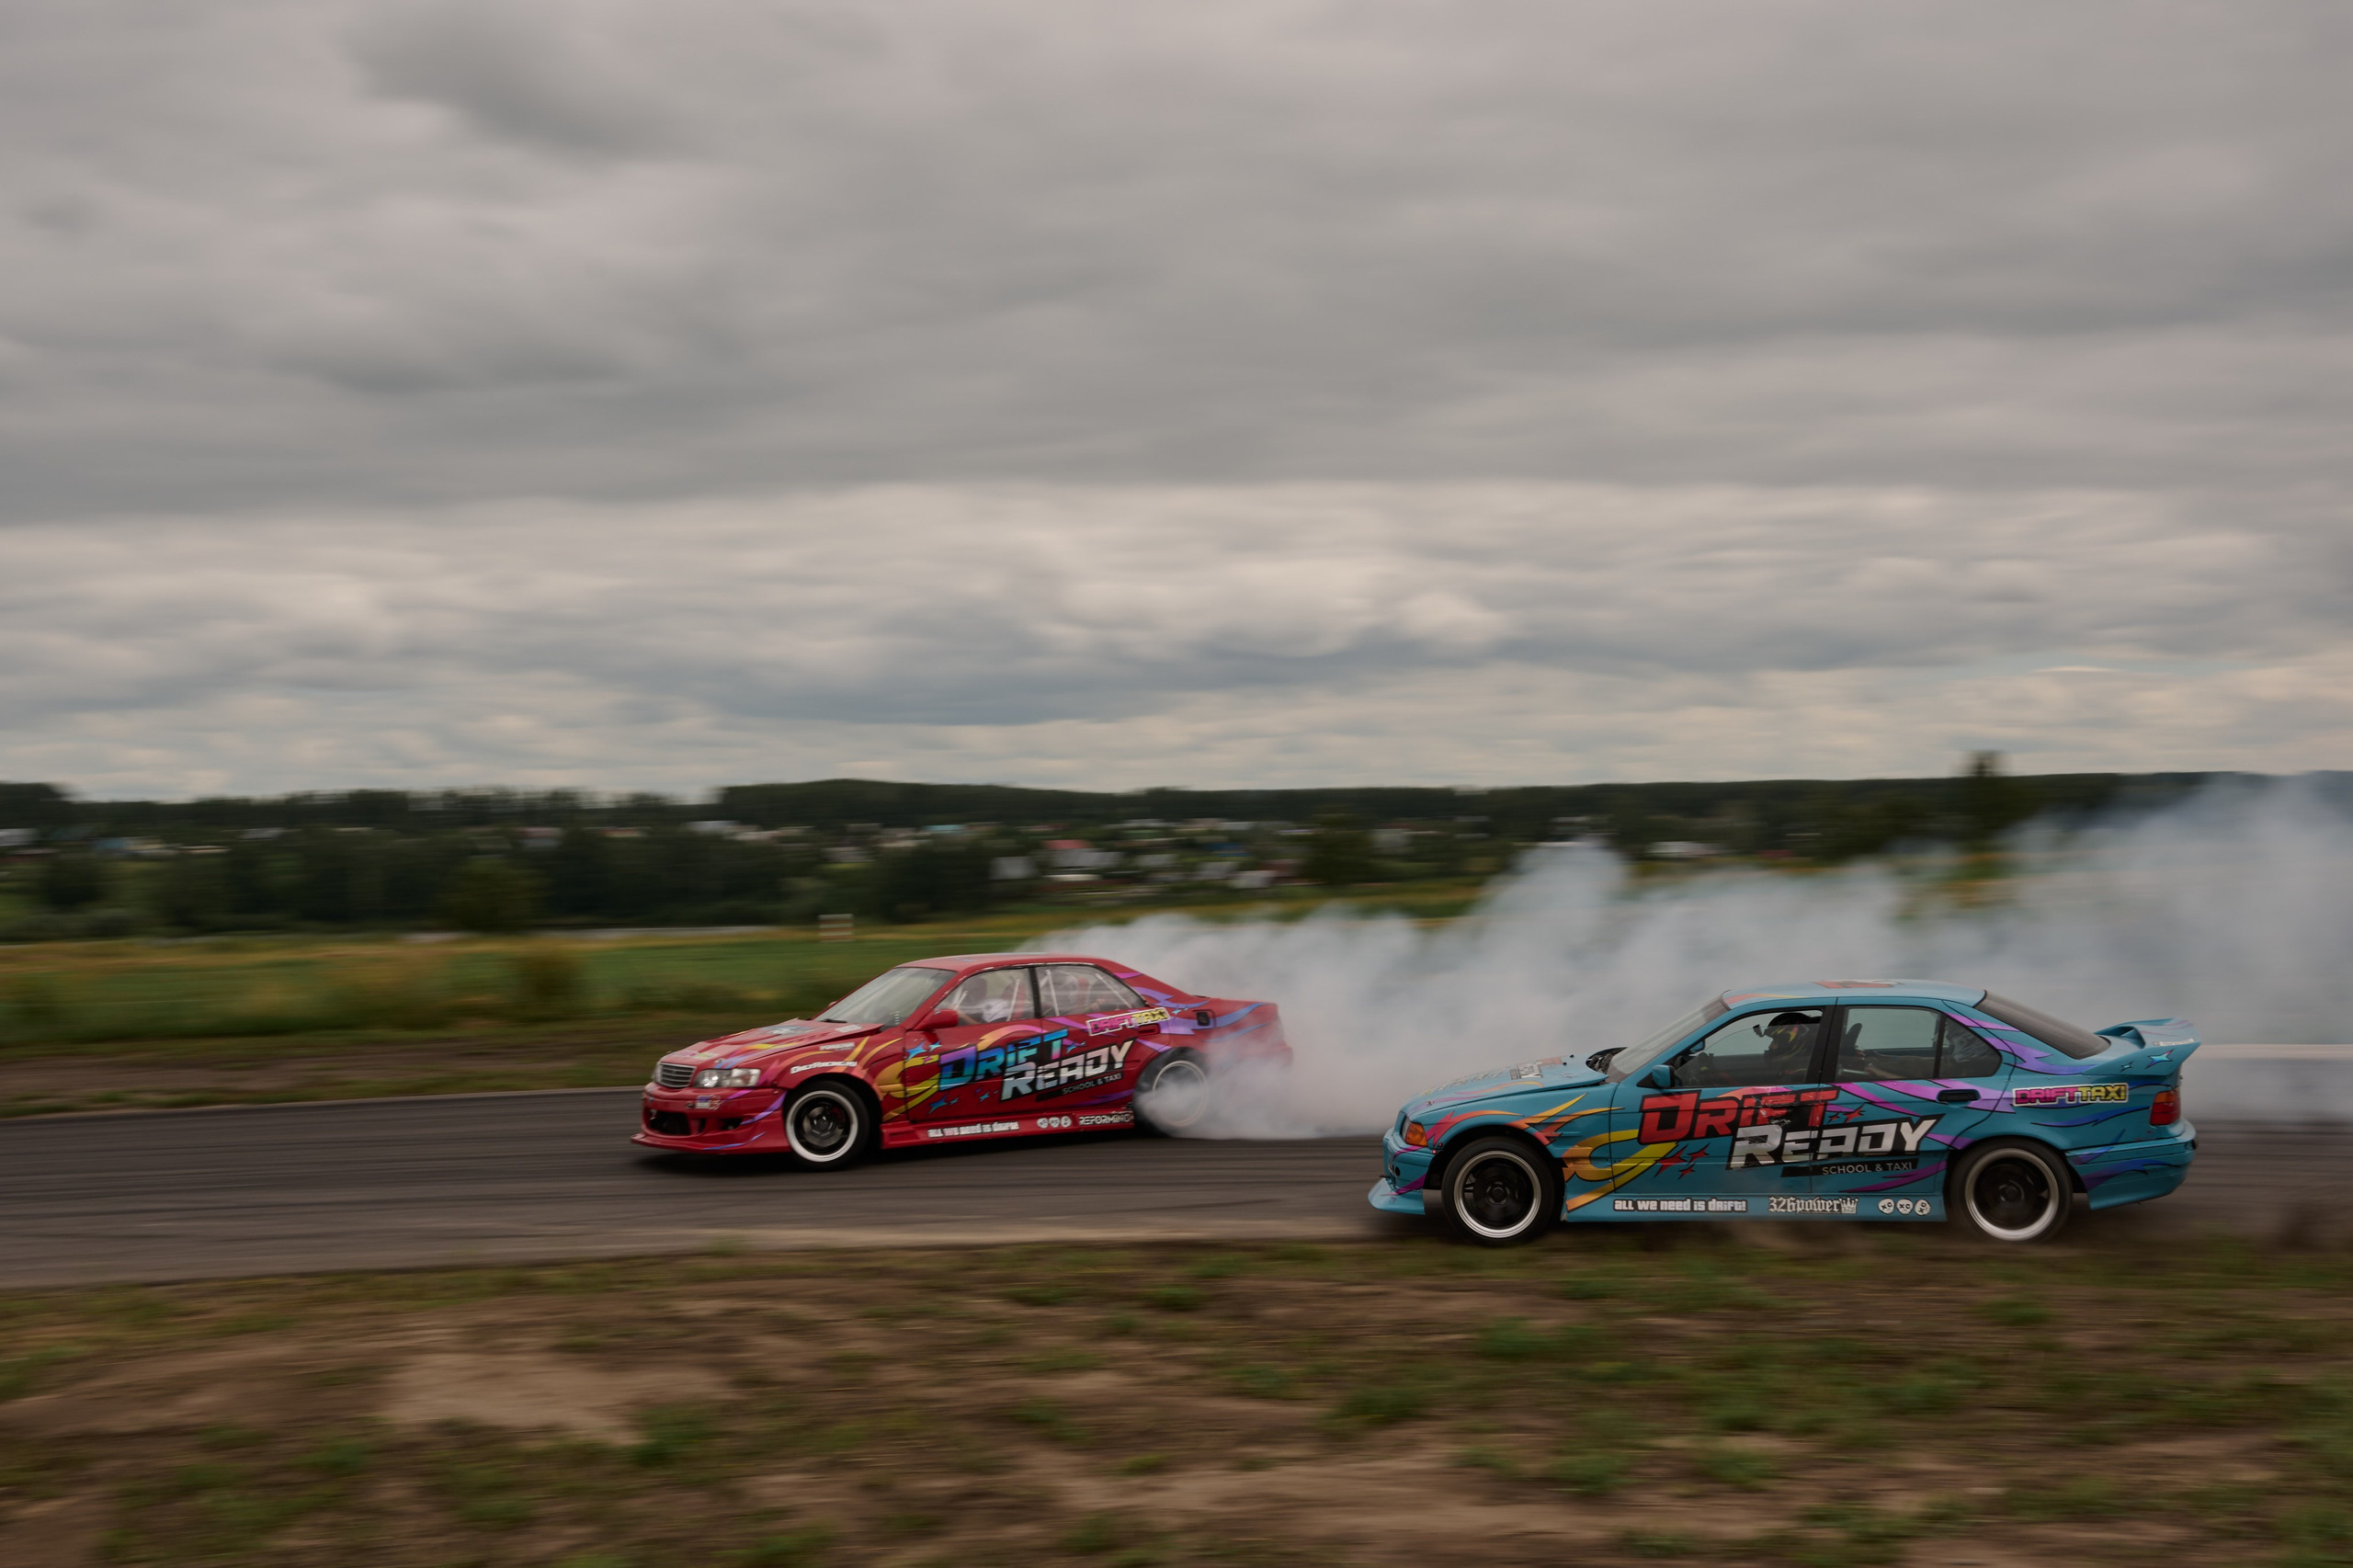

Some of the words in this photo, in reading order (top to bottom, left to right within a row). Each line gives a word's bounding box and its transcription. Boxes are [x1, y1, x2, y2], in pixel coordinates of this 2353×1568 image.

[939, 1028, 1069, 1091] DRIFT
[1001, 1040, 1134, 1101] READY
[1063, 1081, 1096, 1094] SCHOOL
[1104, 1072, 1122, 1082] TAXI
[1640, 1090, 1838, 1143] DRIFT
[1730, 1119, 1937, 1167] READY
[1822, 1164, 1871, 1175] SCHOOL
[1875, 1164, 1882, 1172] &
[1886, 1162, 1912, 1171] TAXI
[1660, 1199, 1691, 1211] need
[1693, 1200, 1706, 1211] is
